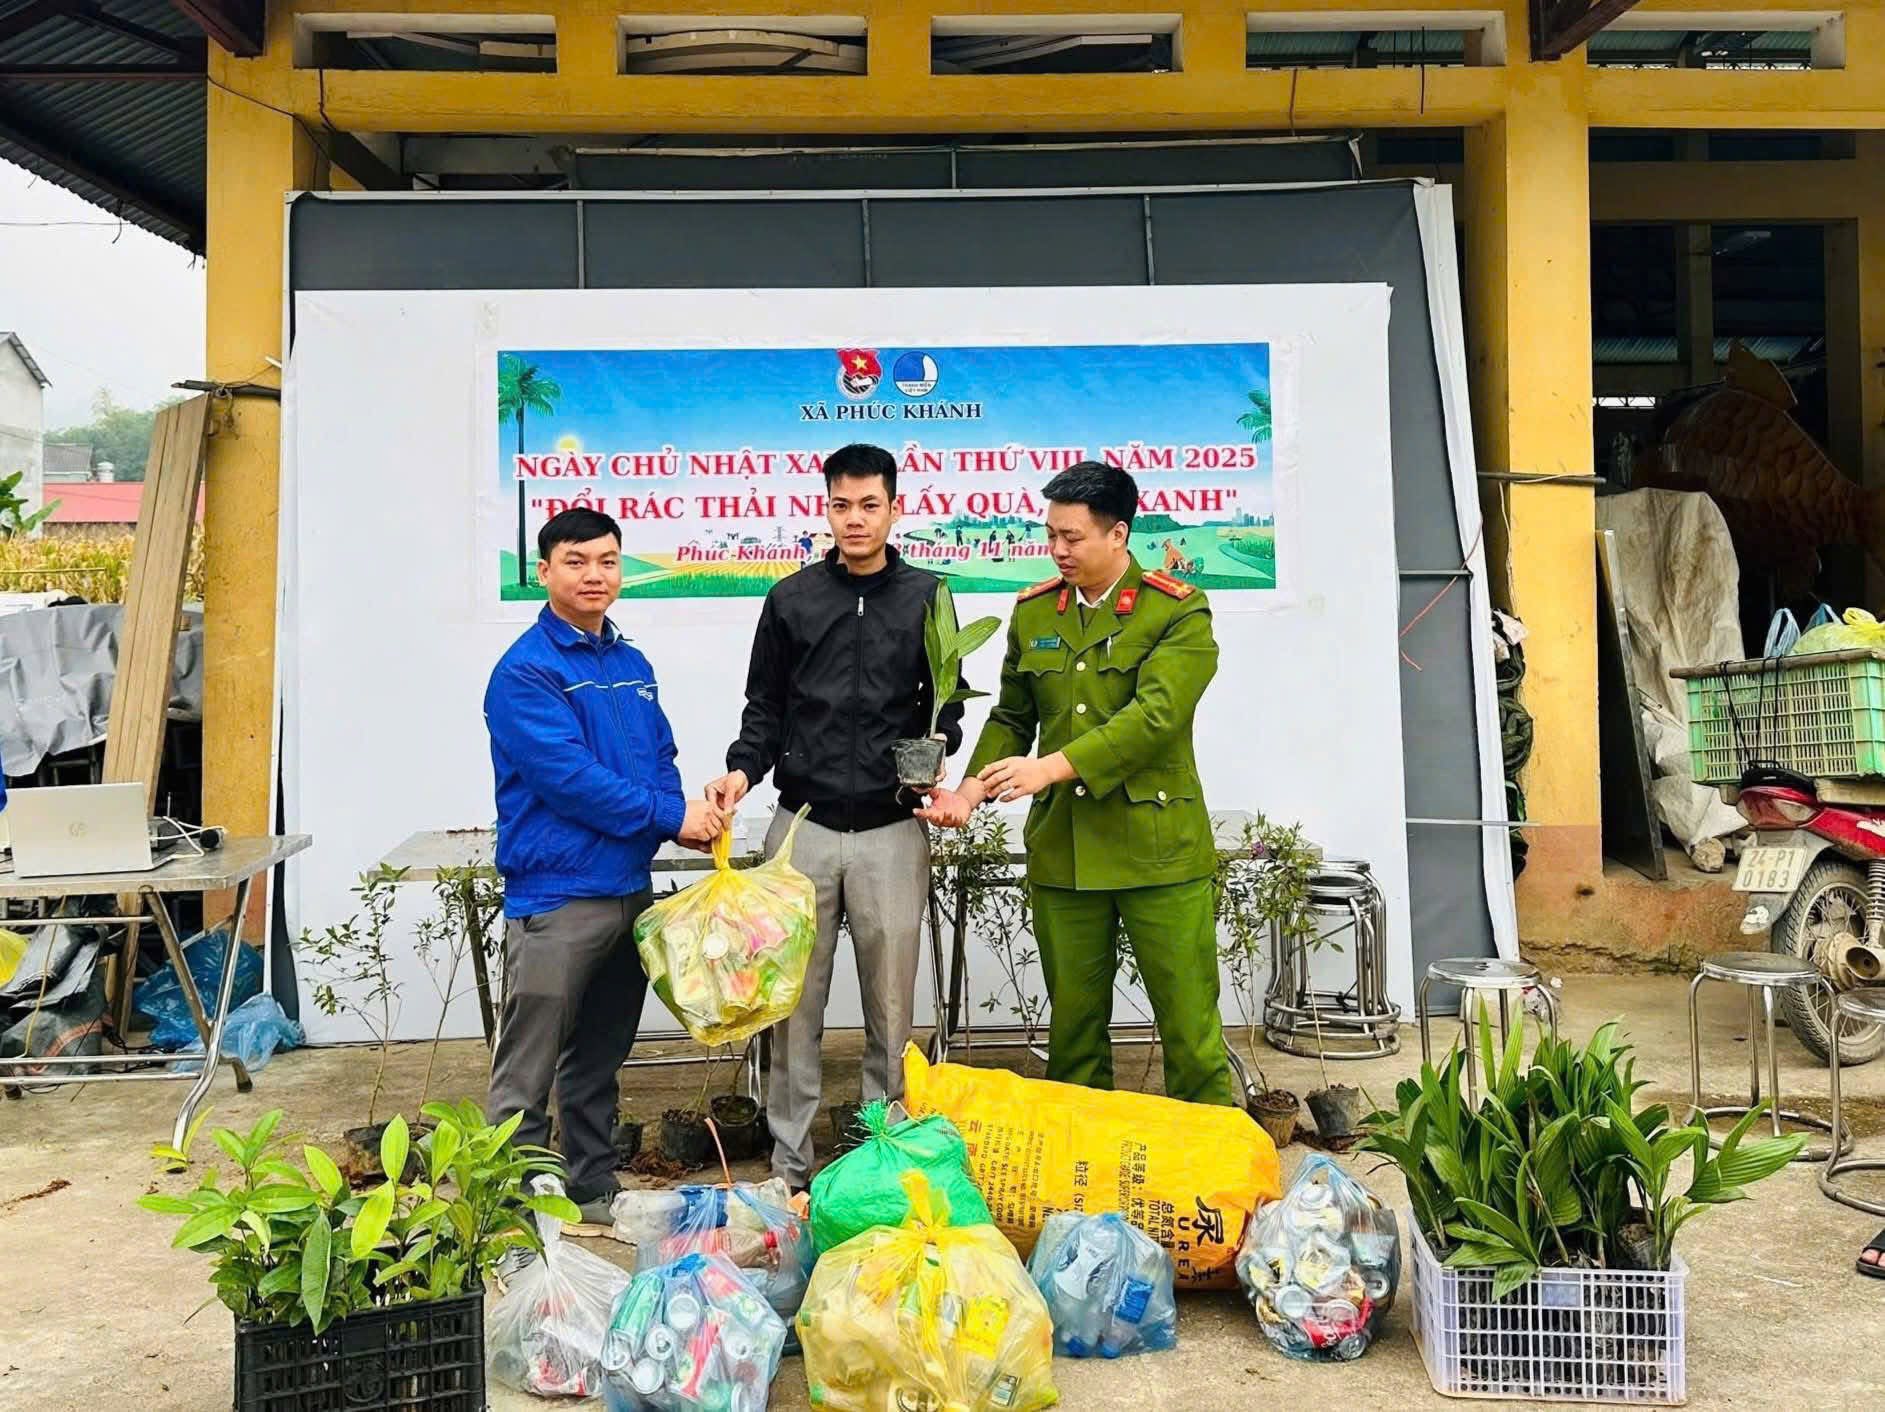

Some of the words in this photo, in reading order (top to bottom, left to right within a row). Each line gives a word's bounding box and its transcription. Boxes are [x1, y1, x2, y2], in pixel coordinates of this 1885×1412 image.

[801, 403, 829, 420] XÃ
[836, 402, 896, 420] PHÚC
[903, 401, 982, 419] KHÁNH
[516, 451, 602, 479] NGÀY
[612, 447, 678, 476] CHỦ
[690, 453, 776, 481] NHẬT
[786, 453, 826, 475] XA
[954, 448, 1024, 471] THỨ
[1104, 444, 1173, 469] NĂM
[1185, 447, 1255, 469] 2025
[620, 490, 684, 519] RÁC
[695, 488, 776, 518] THẢI
[897, 485, 955, 515] LẤY
[968, 487, 1044, 518] QUÀ,
[910, 541, 970, 560] tháng
[1743, 870, 1790, 888] 0183
[1148, 1200, 1161, 1225] TOTAL
